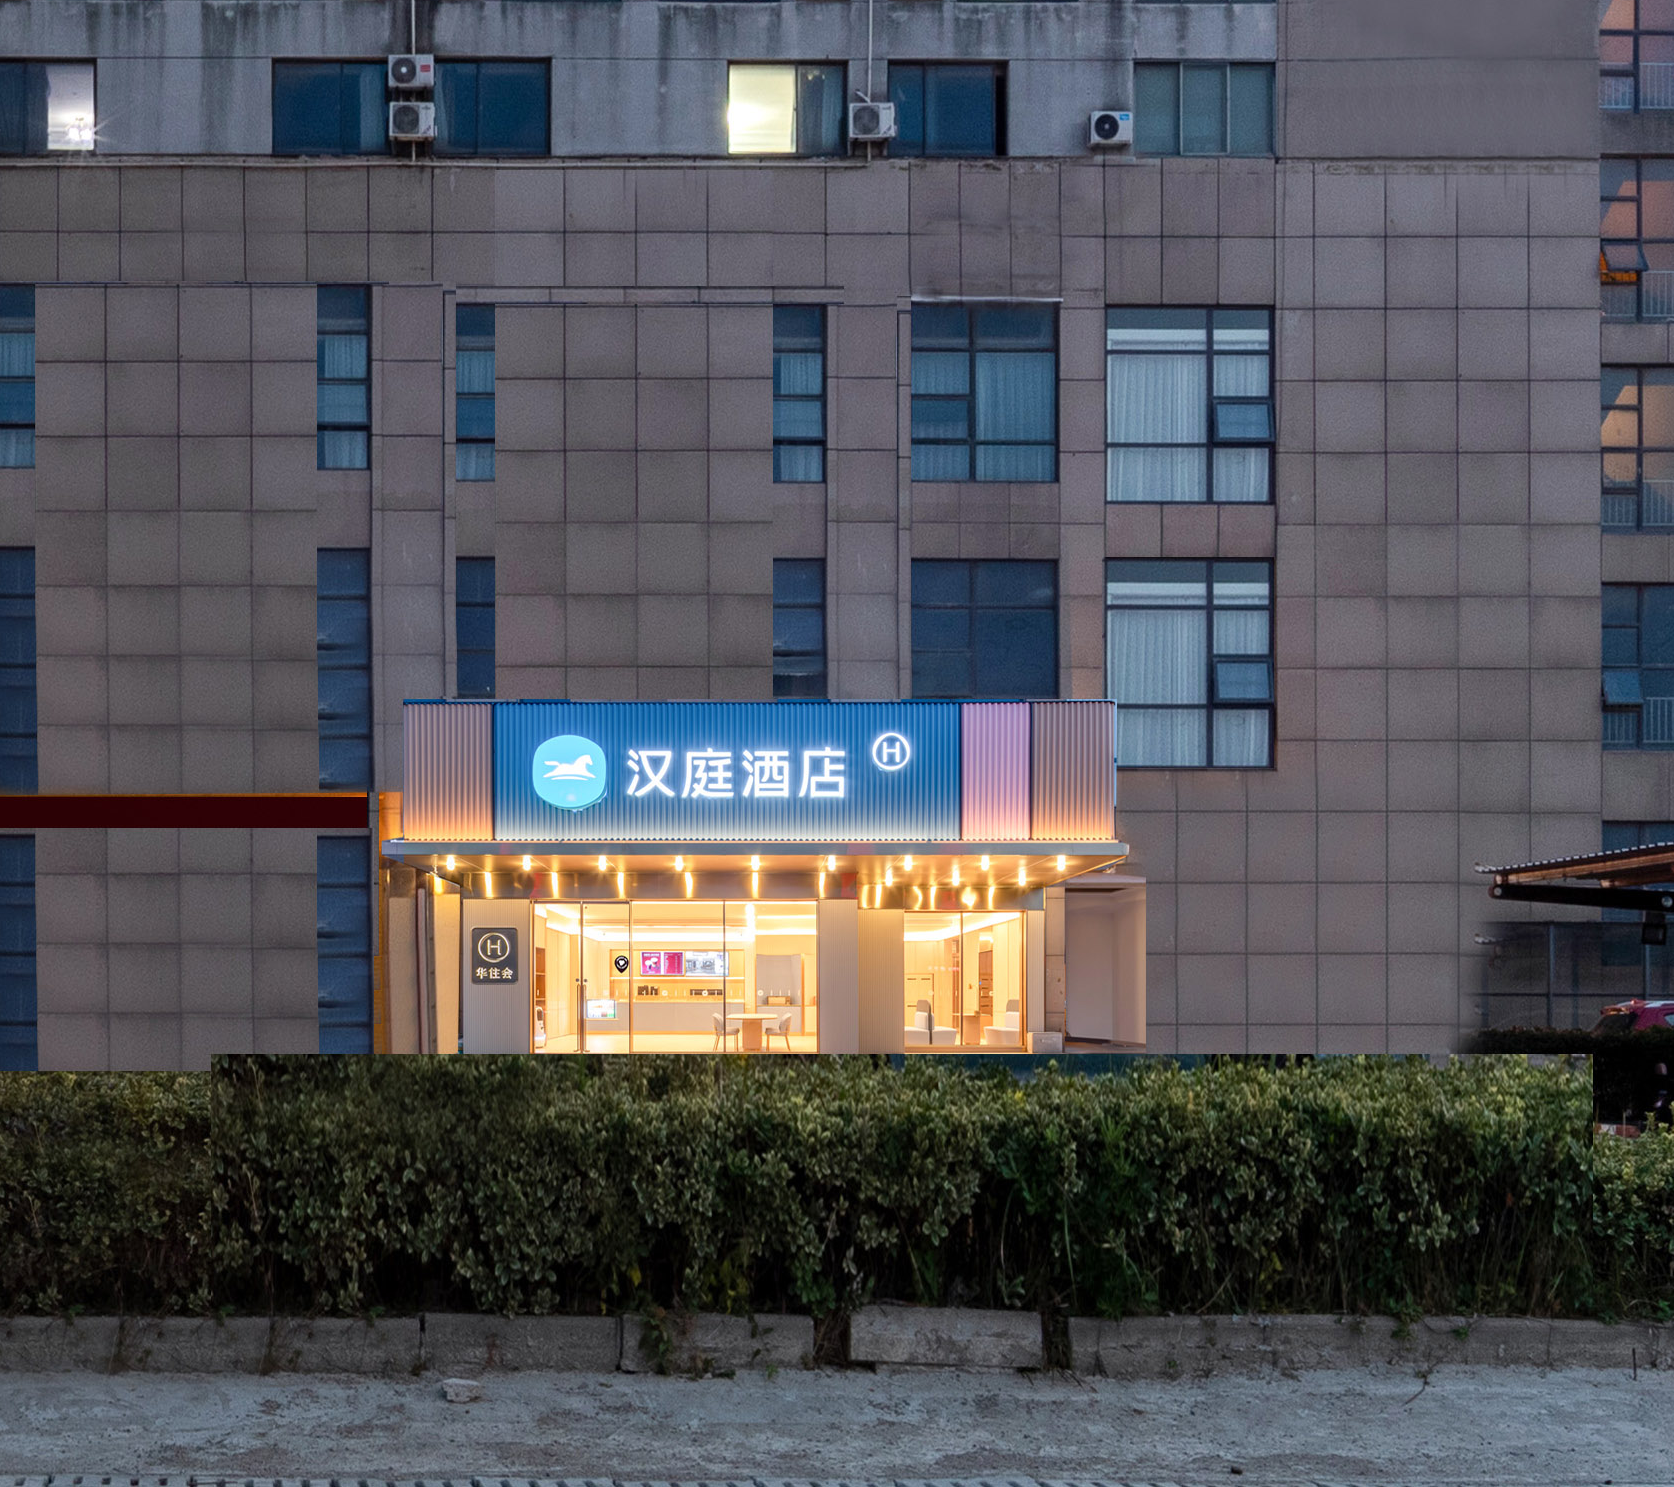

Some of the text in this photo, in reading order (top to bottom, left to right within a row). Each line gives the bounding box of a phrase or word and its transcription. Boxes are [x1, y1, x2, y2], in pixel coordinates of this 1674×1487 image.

[627, 746, 846, 799] 汉庭酒店
[475, 966, 514, 980] 华住会
